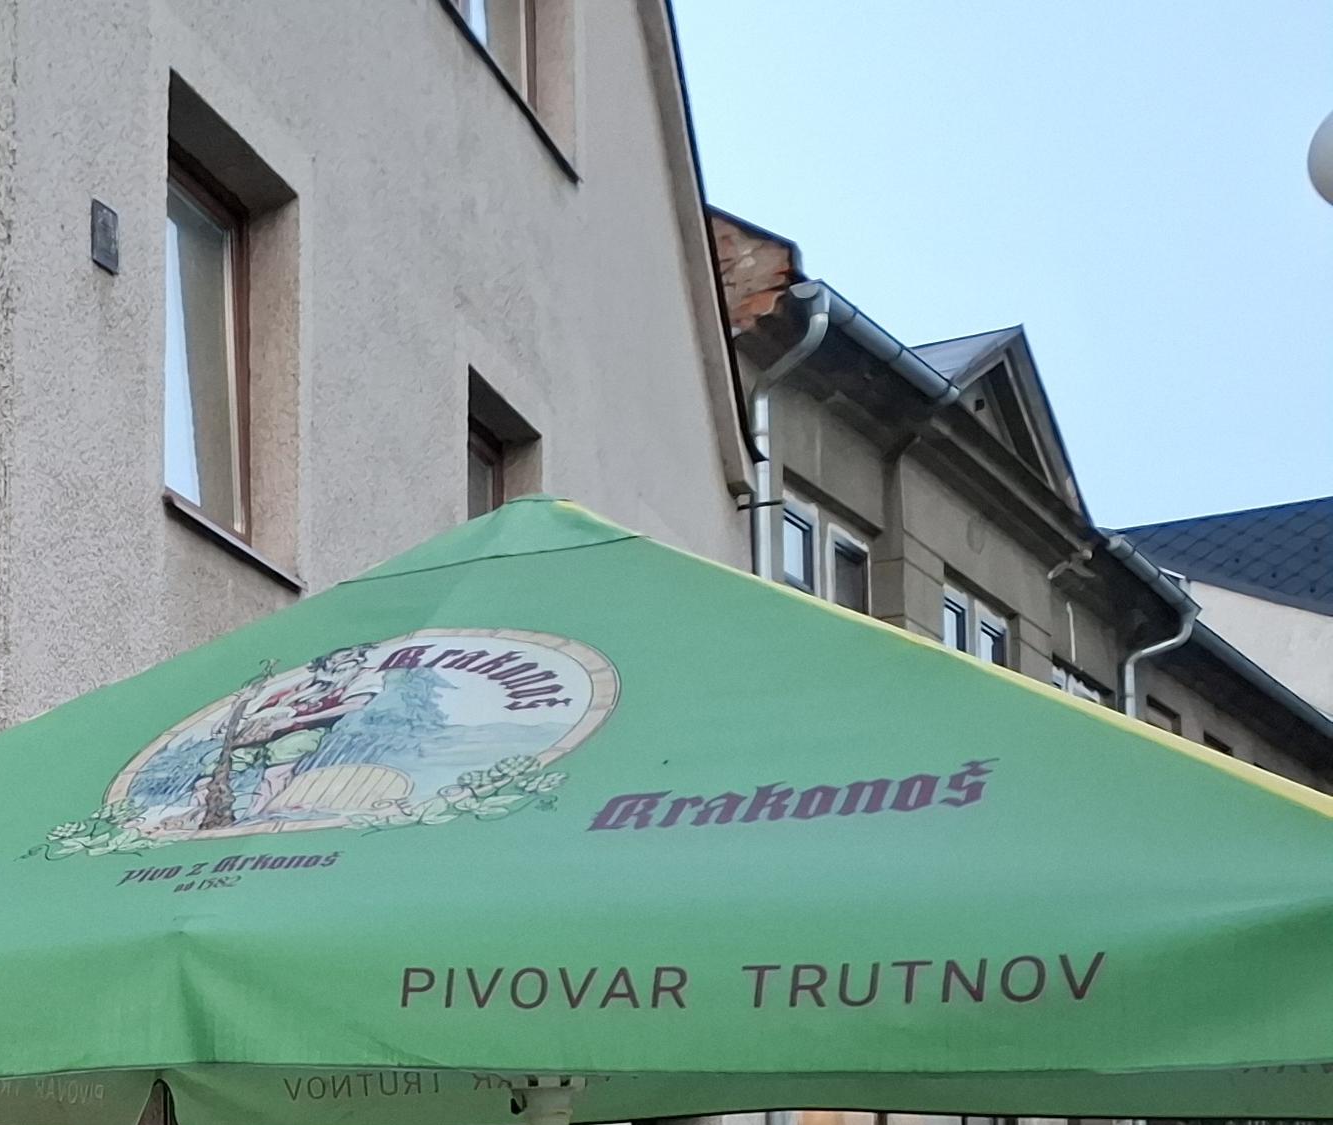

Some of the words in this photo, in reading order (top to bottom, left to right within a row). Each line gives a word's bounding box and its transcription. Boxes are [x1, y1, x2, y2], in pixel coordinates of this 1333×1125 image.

[374, 643, 573, 711] Krakonoš
[585, 757, 999, 833] Krakonoš
[116, 865, 183, 888] Pivo
[196, 874, 243, 891] 1582
[399, 965, 690, 1010] PIVOVAR
[740, 950, 1108, 1010] TRUTNOV
